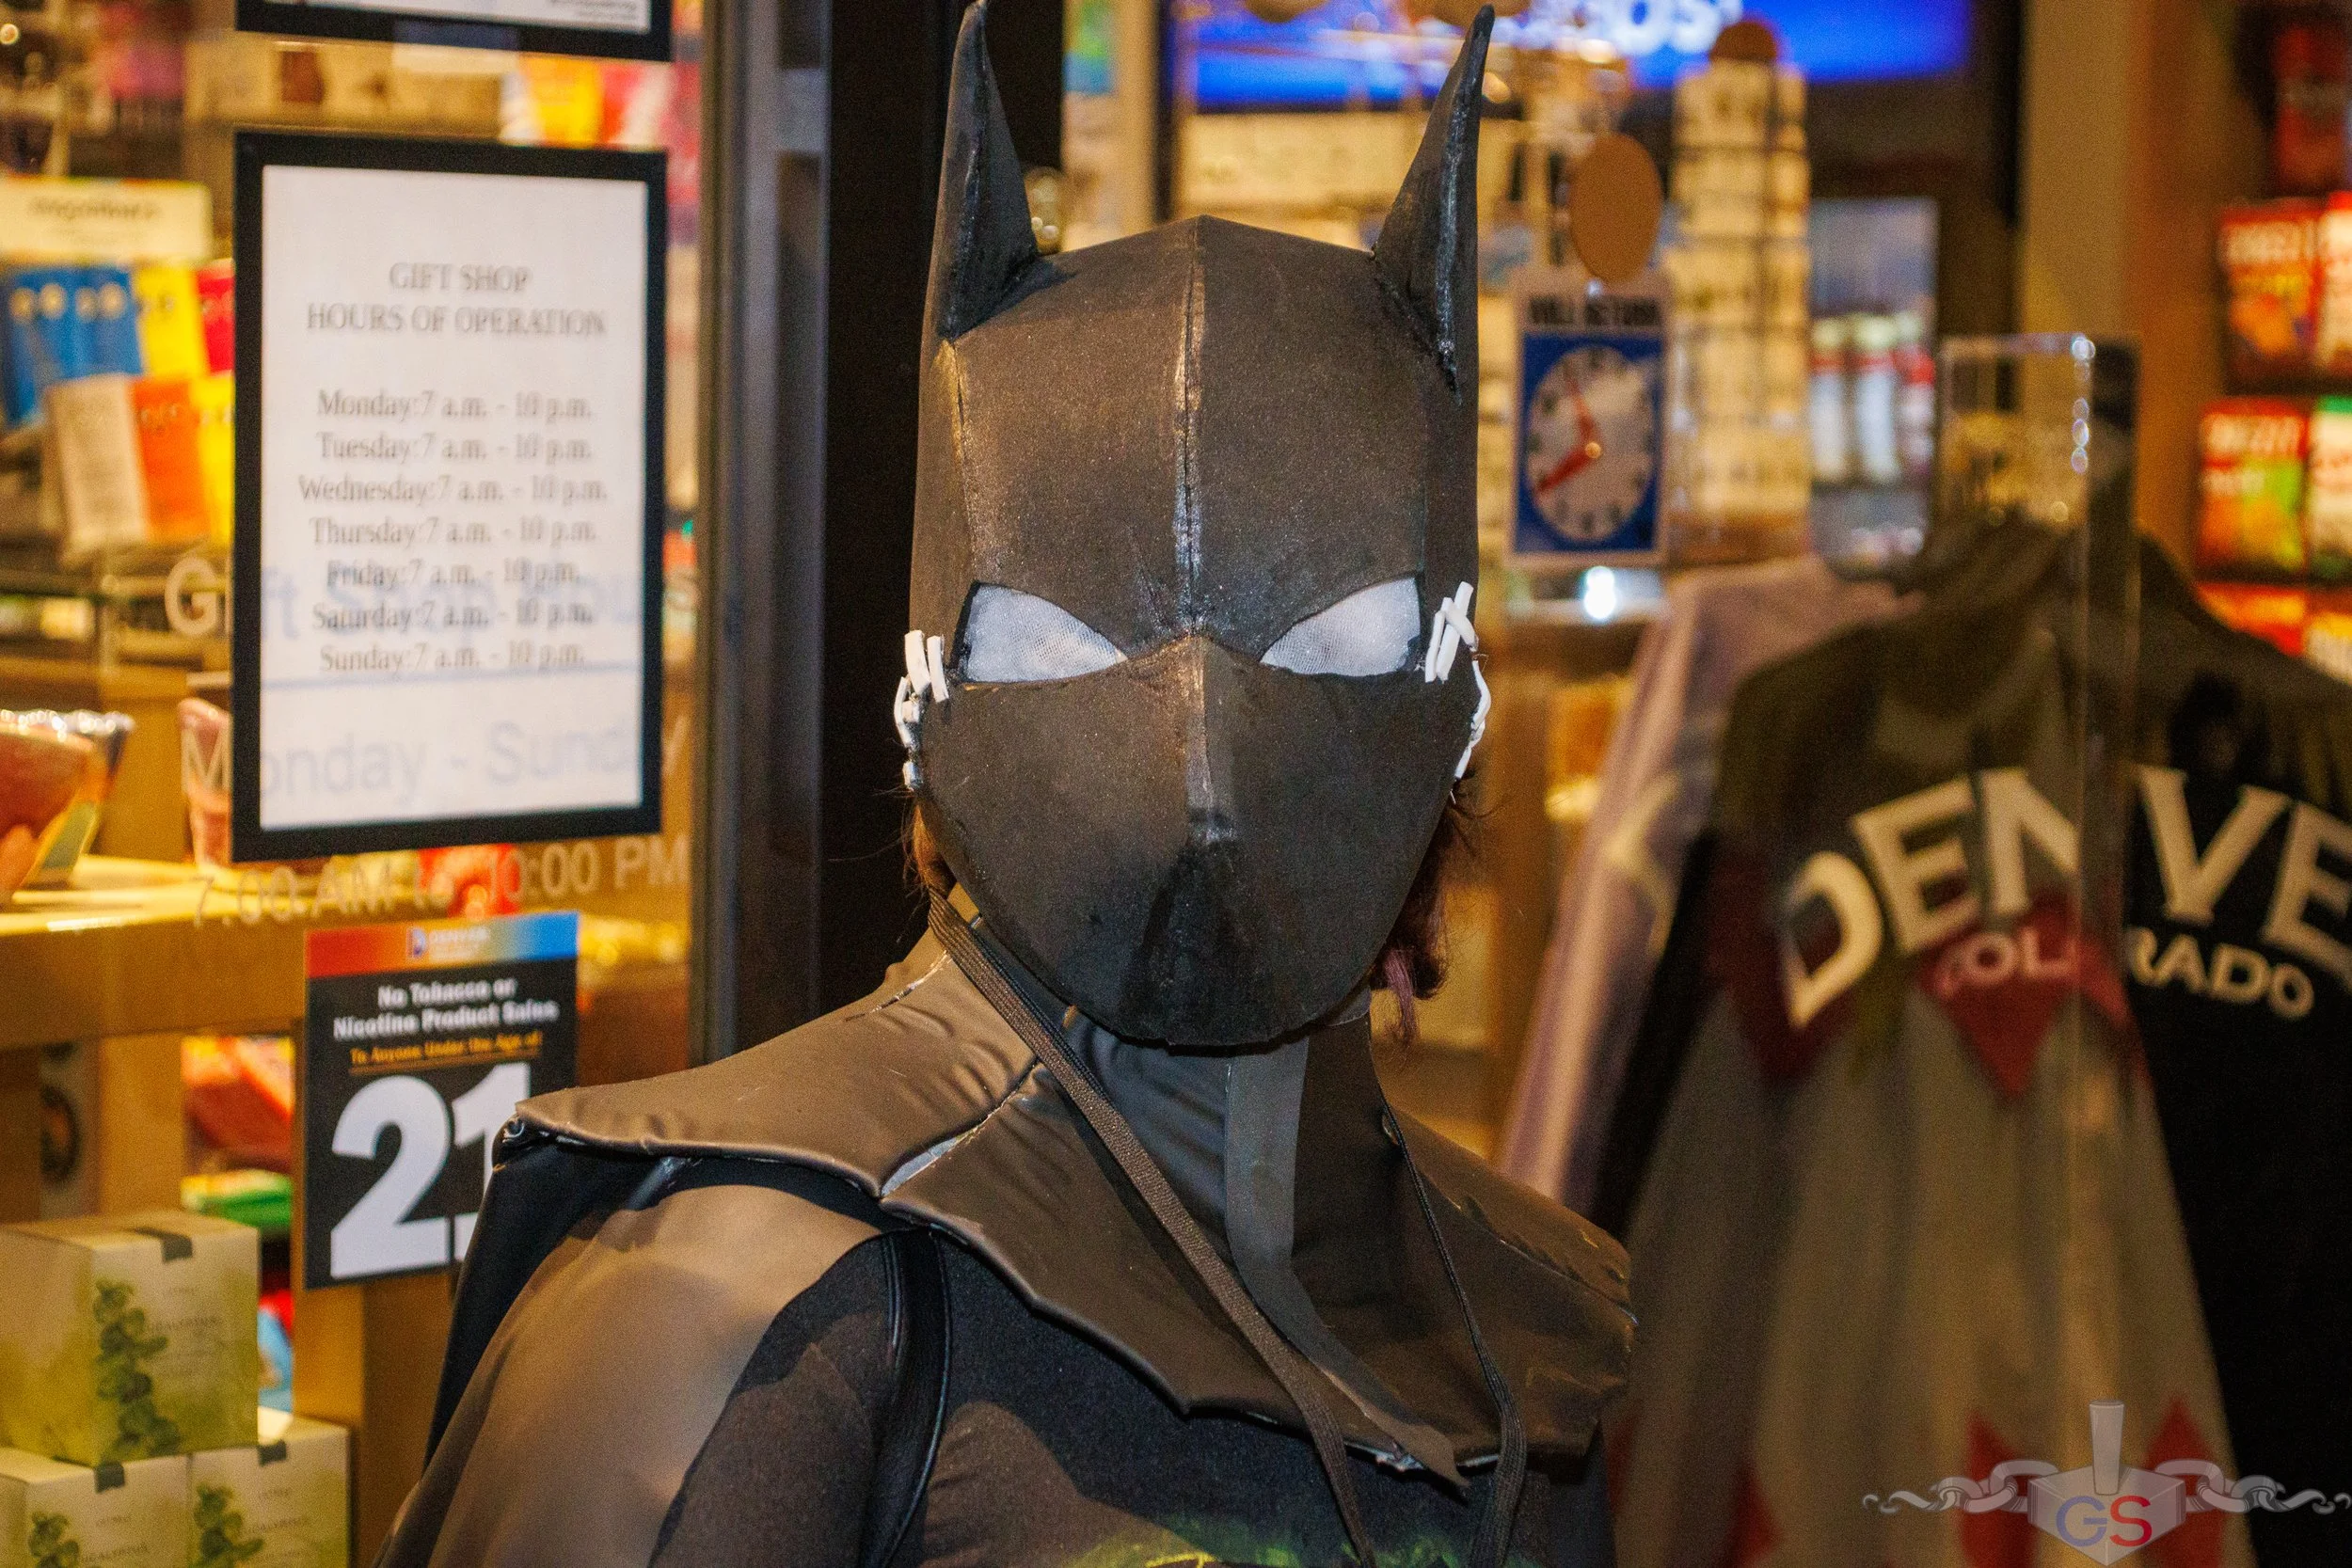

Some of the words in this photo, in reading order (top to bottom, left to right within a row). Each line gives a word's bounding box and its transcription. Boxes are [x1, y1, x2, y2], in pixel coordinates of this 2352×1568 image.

[389, 261, 453, 290] GIFT
[459, 264, 532, 292] SHOP
[307, 302, 403, 331] HOURS
[411, 305, 448, 332] OF
[453, 307, 609, 336] OPERATION
[516, 389, 542, 417] 10
[515, 433, 540, 460] 10
[531, 474, 556, 501] 10
[519, 515, 545, 542] 10
[504, 557, 531, 582] 10
[516, 599, 541, 625] 10
[507, 641, 532, 664] 10
[310, 852, 395, 917] AM
[613, 833, 688, 890] PM
[377, 985, 406, 1009] No
[408, 980, 491, 1007] Tobacco
[493, 977, 516, 999] or
[333, 1012, 420, 1040] Nicotine
[421, 1003, 500, 1032] Product
[501, 998, 560, 1024] Sales
[350, 1046, 369, 1065] To
[371, 1045, 422, 1064] Anyone
[423, 1039, 465, 1057] Under
[523, 1030, 543, 1046] of
[330, 1061, 532, 1280] 21
